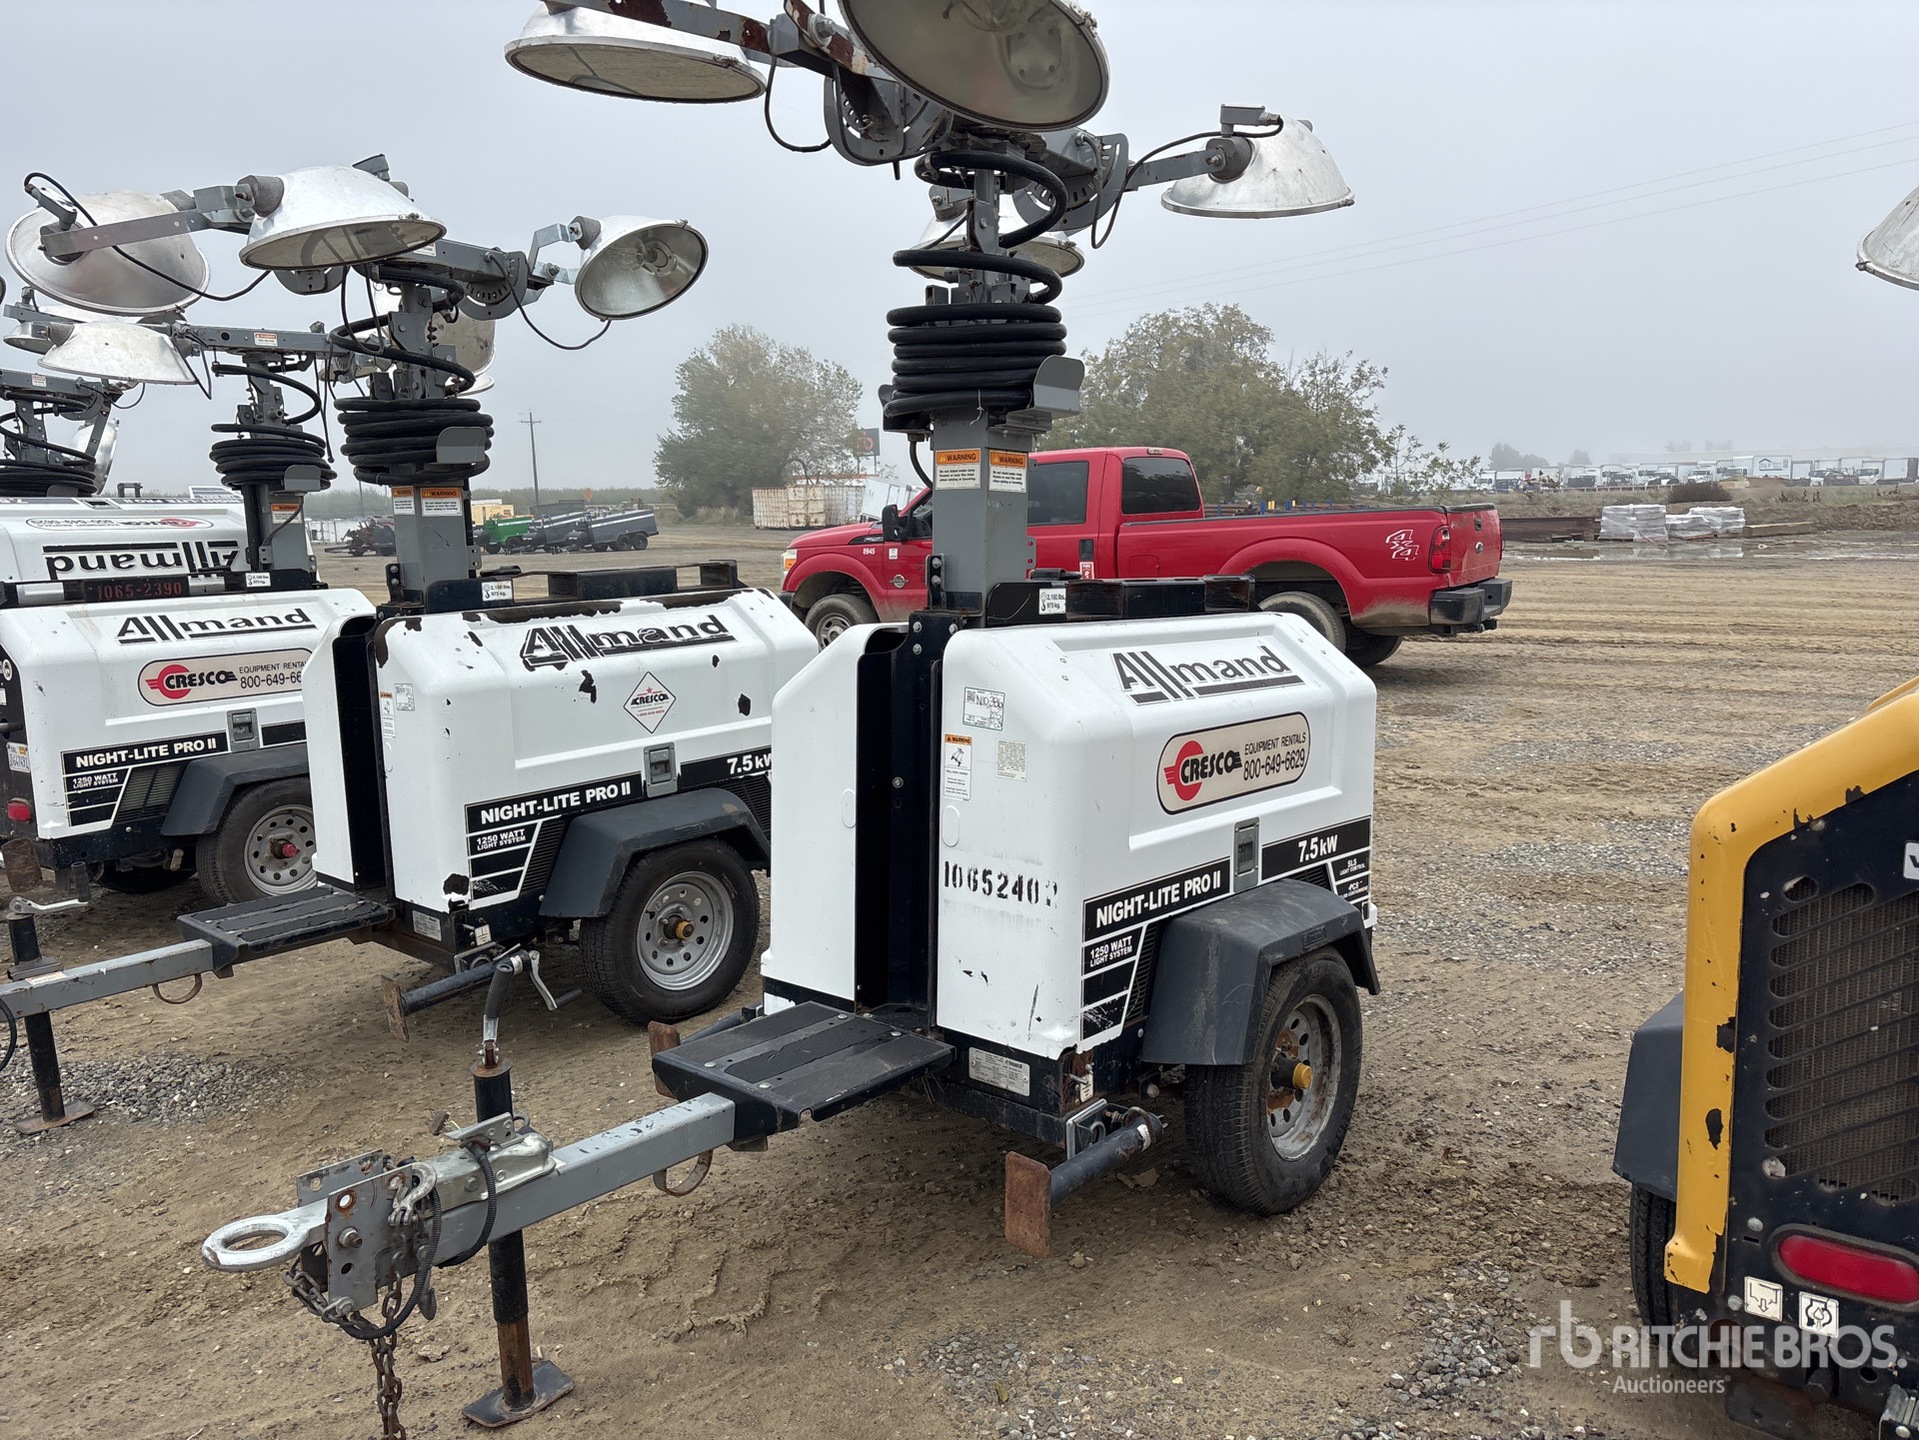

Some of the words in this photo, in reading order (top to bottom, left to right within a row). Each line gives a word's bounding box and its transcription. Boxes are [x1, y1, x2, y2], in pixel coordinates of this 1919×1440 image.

[947, 453, 976, 461] WARNING
[1000, 456, 1023, 465] WARNING
[45, 541, 238, 580] Allmand
[117, 608, 312, 641] Allmand
[524, 615, 729, 661] Allmand
[239, 664, 279, 674] EQUIPMENT
[283, 661, 306, 669] RENTA
[1113, 645, 1292, 699] Allmand
[165, 670, 237, 689] CRESCO
[240, 670, 302, 689] 800-649-66
[632, 694, 668, 705] CRESCO
[76, 744, 169, 768] NIGHT-LITE
[174, 740, 204, 754] PRO
[207, 738, 216, 749] II
[1244, 738, 1279, 755] EQUIPMENT
[1281, 732, 1306, 747] RENTALS
[727, 754, 753, 774] 7.5
[1181, 750, 1241, 783] CRESCO
[1243, 748, 1305, 781] 800-649-6629
[72, 776, 92, 785] 1250
[94, 772, 117, 781] WATT
[481, 792, 580, 824] NIGHT-LITE
[586, 784, 618, 803] PRO
[621, 782, 631, 795] II
[477, 834, 497, 845] 1250
[500, 829, 525, 840] WATT
[477, 841, 497, 851] LIGHT
[500, 835, 526, 846] SYSTEM
[1298, 837, 1318, 862] 7.5
[1320, 835, 1338, 856] kW
[1096, 883, 1180, 928] NIGHT-LITE
[1184, 874, 1211, 899] PRO
[1213, 870, 1221, 889] II
[1090, 945, 1109, 959] 1250
[1110, 936, 1132, 952] WATT
[1090, 953, 1108, 967] LIGHT
[1109, 945, 1132, 960] SYSTEM
